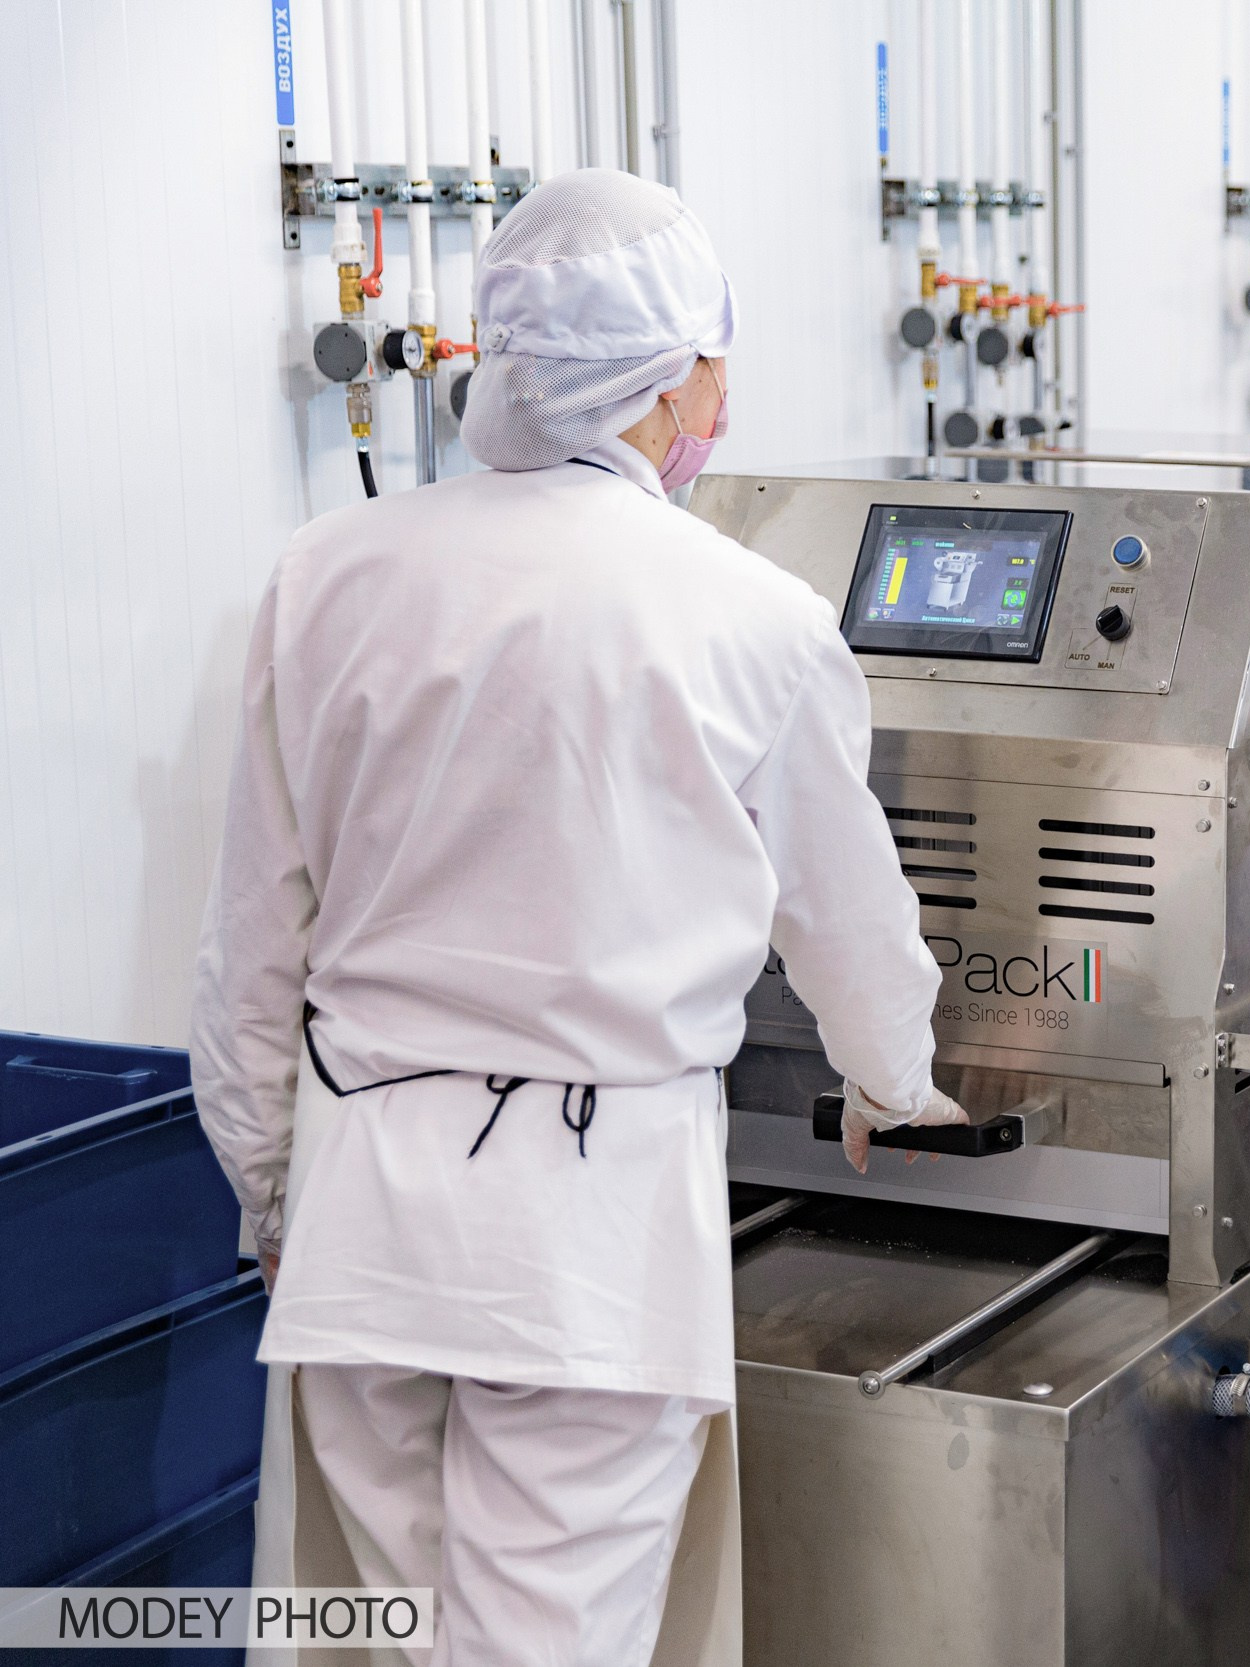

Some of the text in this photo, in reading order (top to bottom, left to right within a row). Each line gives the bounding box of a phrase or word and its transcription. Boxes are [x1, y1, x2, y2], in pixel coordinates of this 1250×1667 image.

[275, 7, 291, 92] ВОЗДУХ
[1110, 586, 1135, 594] RESET
[1068, 653, 1090, 661] AUTO
[924, 935, 1077, 1001] Pack
[968, 1002, 1017, 1026] Since
[1024, 1007, 1069, 1030] 1988
